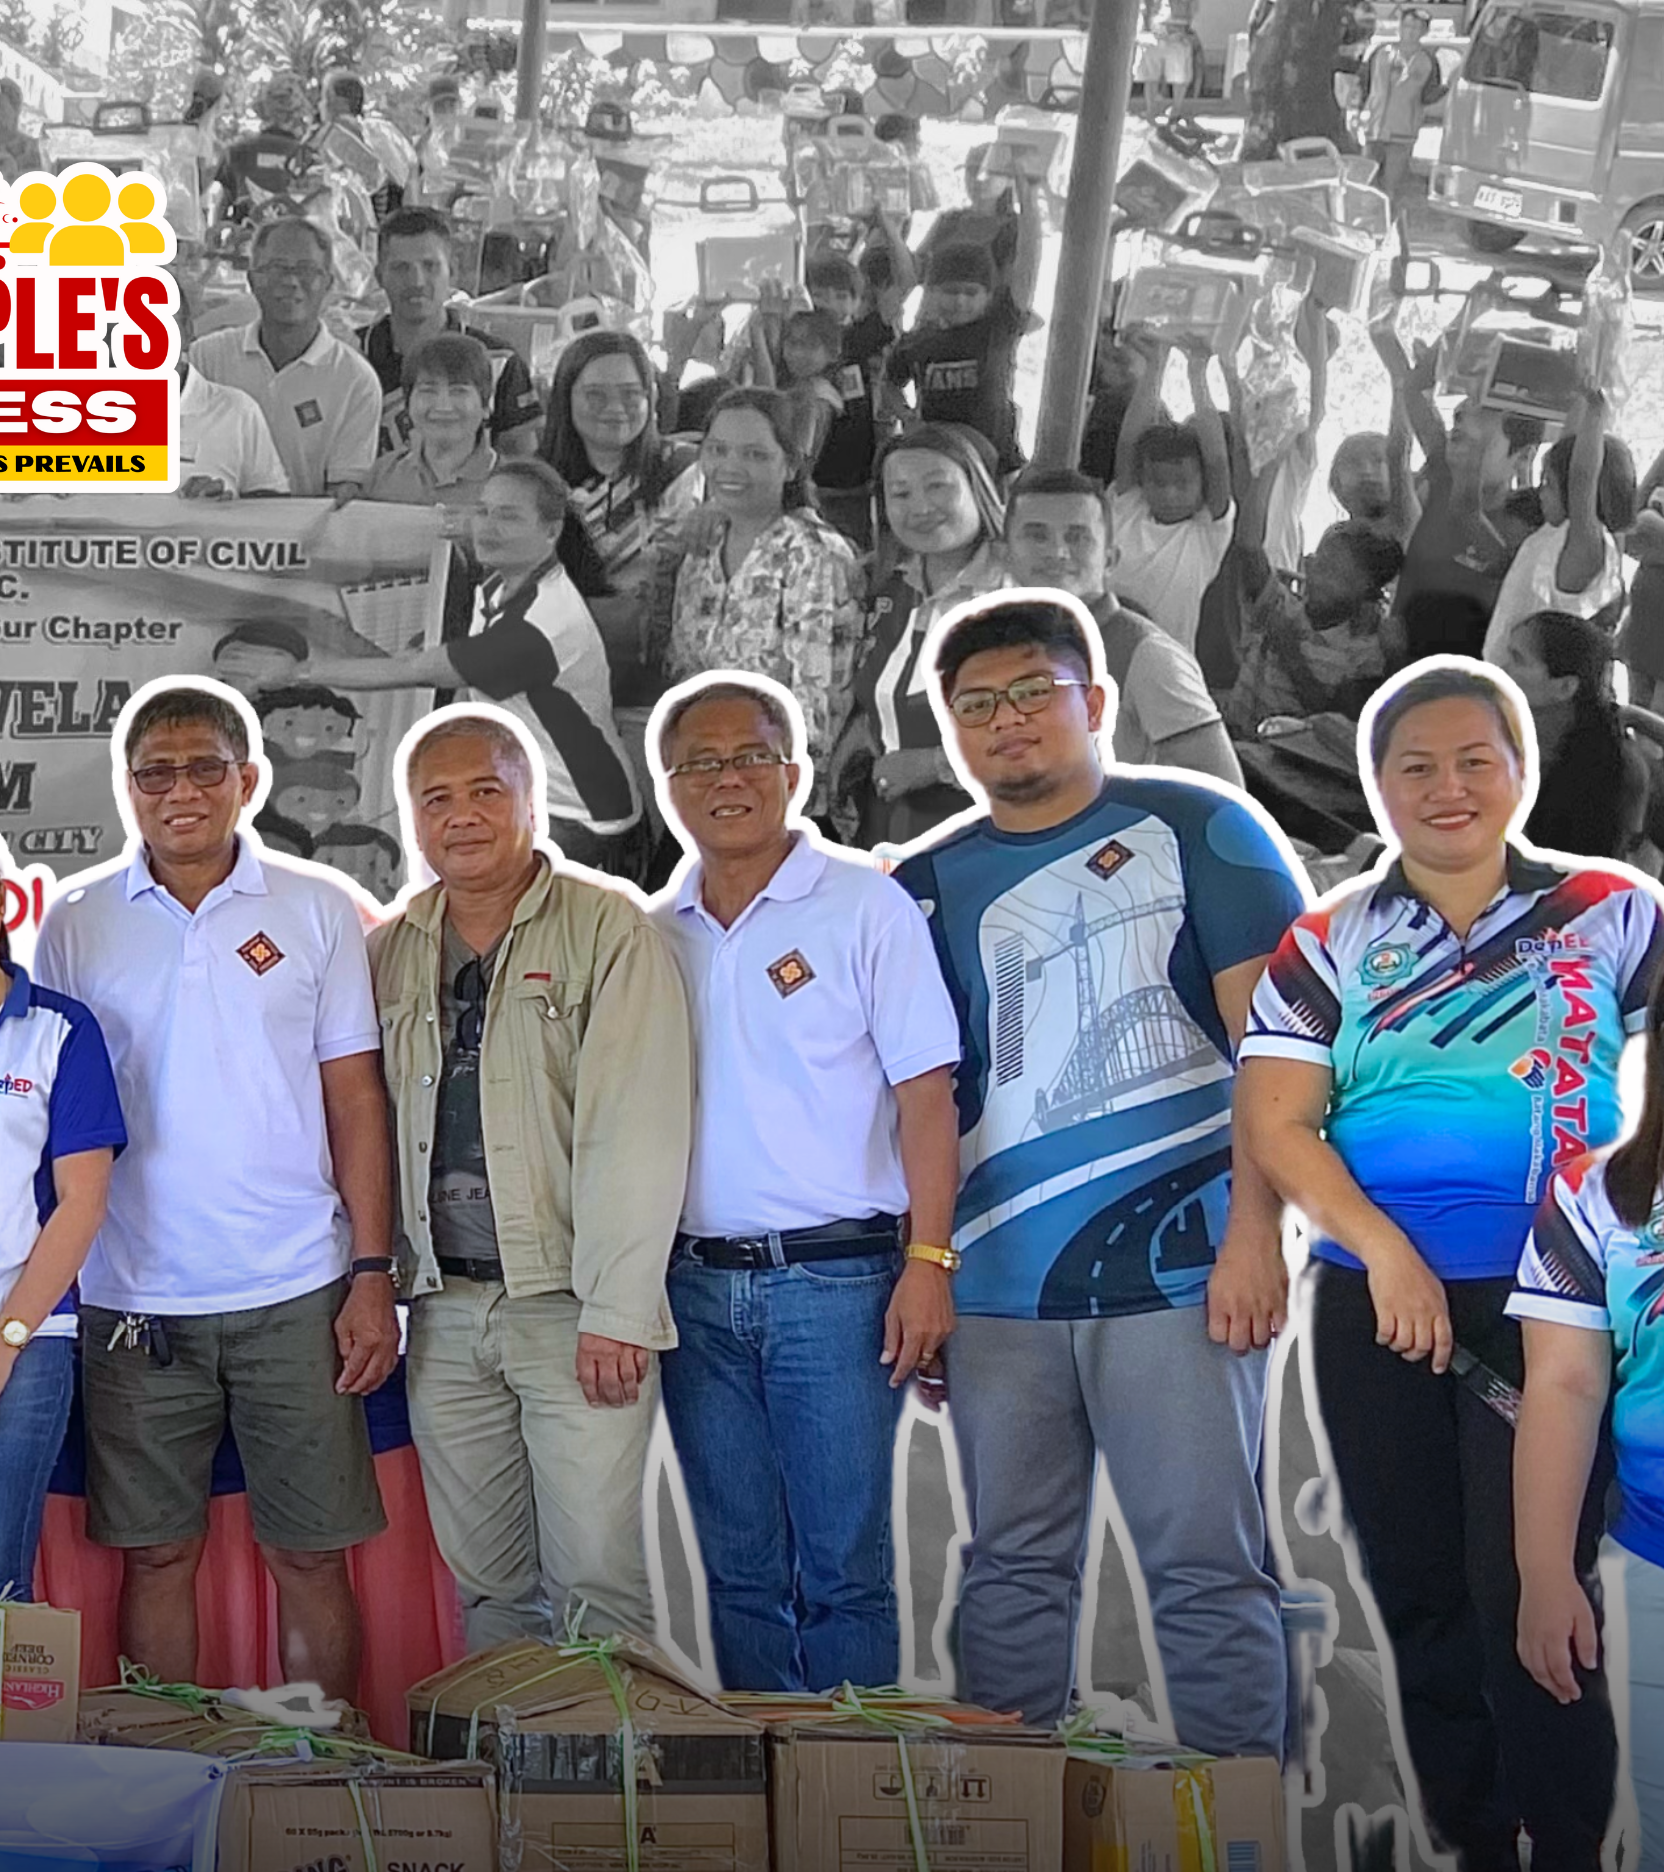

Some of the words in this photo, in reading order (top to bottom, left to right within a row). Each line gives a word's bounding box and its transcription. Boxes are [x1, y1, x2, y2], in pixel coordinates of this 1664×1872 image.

[149, 540, 198, 565] OF
[209, 541, 306, 566] CIVIL
[47, 616, 183, 644] Chapter
[19, 826, 104, 855] CITY
